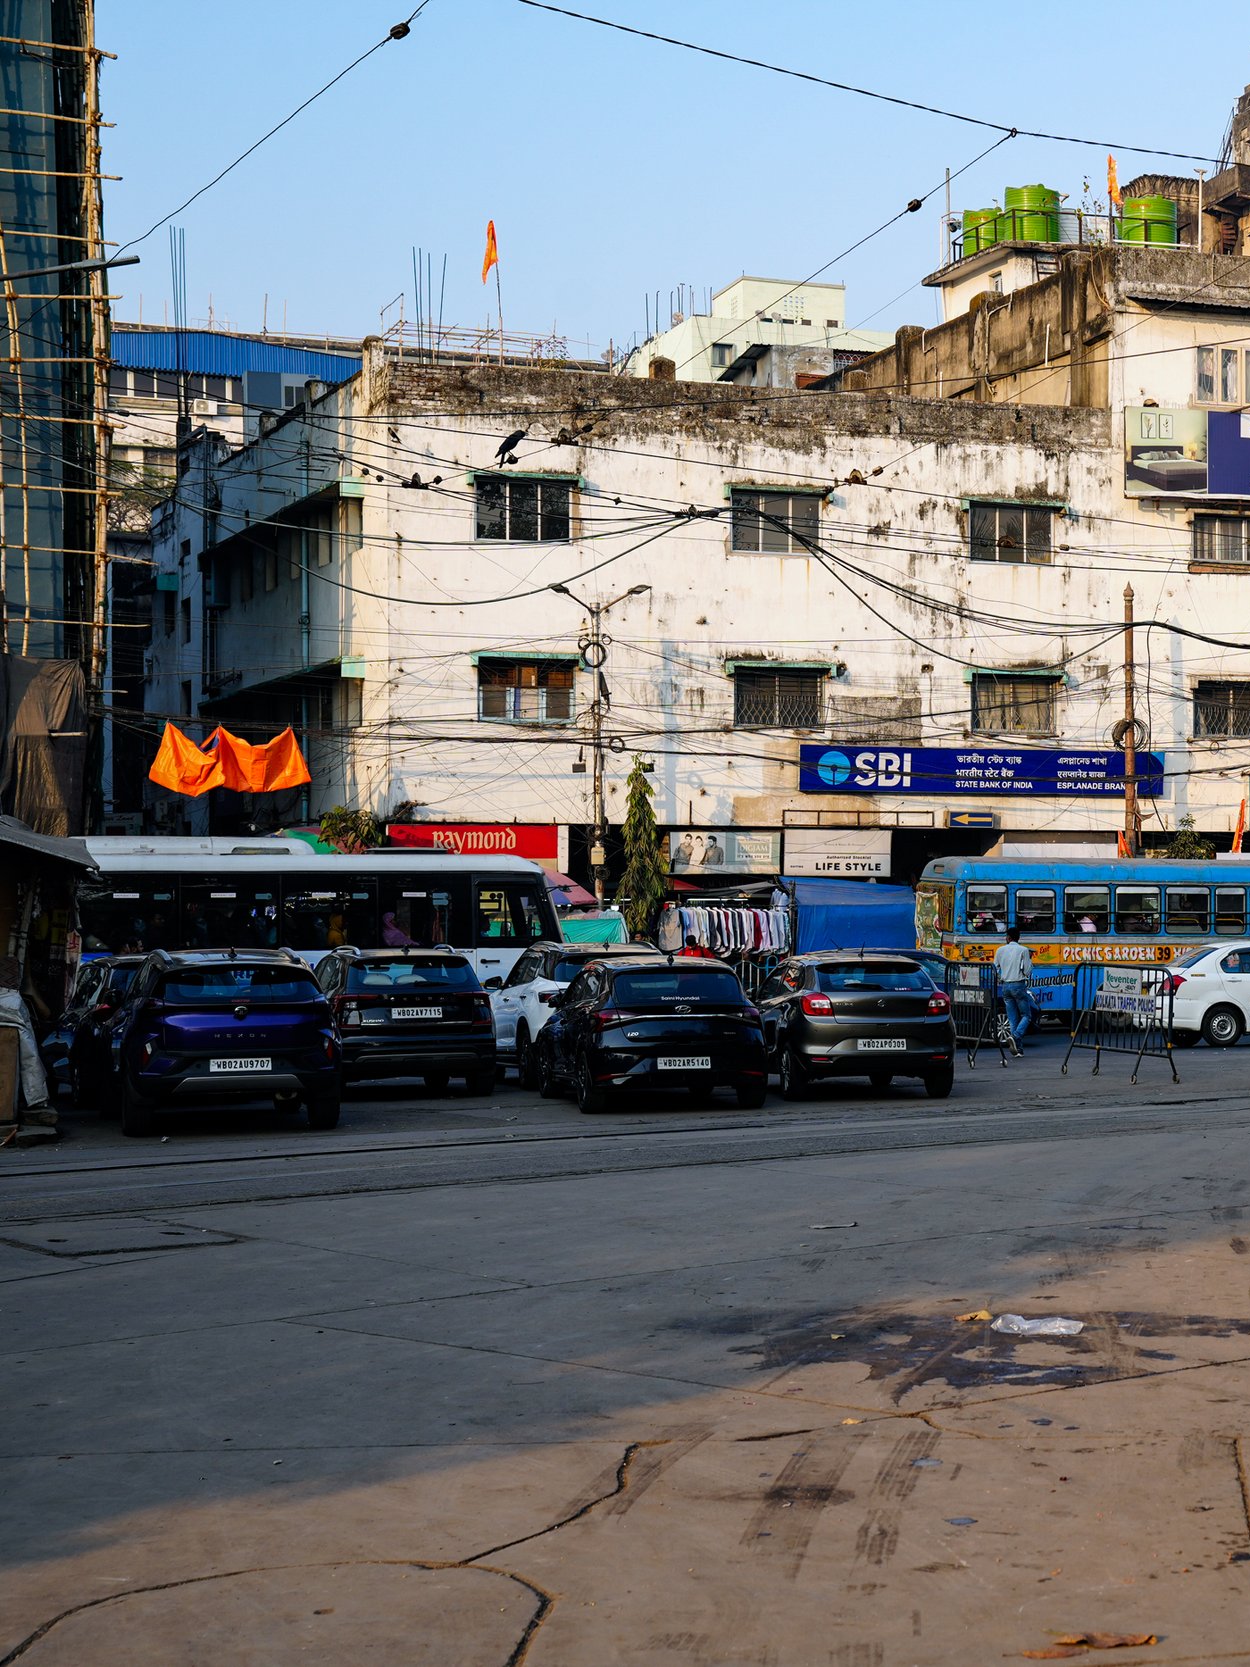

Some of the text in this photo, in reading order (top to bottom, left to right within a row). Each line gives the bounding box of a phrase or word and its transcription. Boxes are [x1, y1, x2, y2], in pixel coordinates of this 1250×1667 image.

[854, 752, 911, 787] SBI
[955, 780, 978, 788] STATE
[1001, 781, 1012, 789] OF
[1013, 781, 1033, 789] INDIA
[1057, 781, 1127, 790] ESPLANADE BRAN
[432, 827, 516, 854] Raymond
[815, 862, 882, 871] LIFE STYLE
[1063, 946, 1104, 961] PICNIC
[1104, 946, 1155, 961] GARDEN
[1156, 946, 1171, 961] 39
[1117, 996, 1137, 1011] TRAFFIC
[1138, 998, 1154, 1013] POLICE
[862, 1040, 905, 1049] WB02AP0309
[216, 1059, 270, 1069] WB02AU9707
[662, 1058, 710, 1067] WB02AR5140
